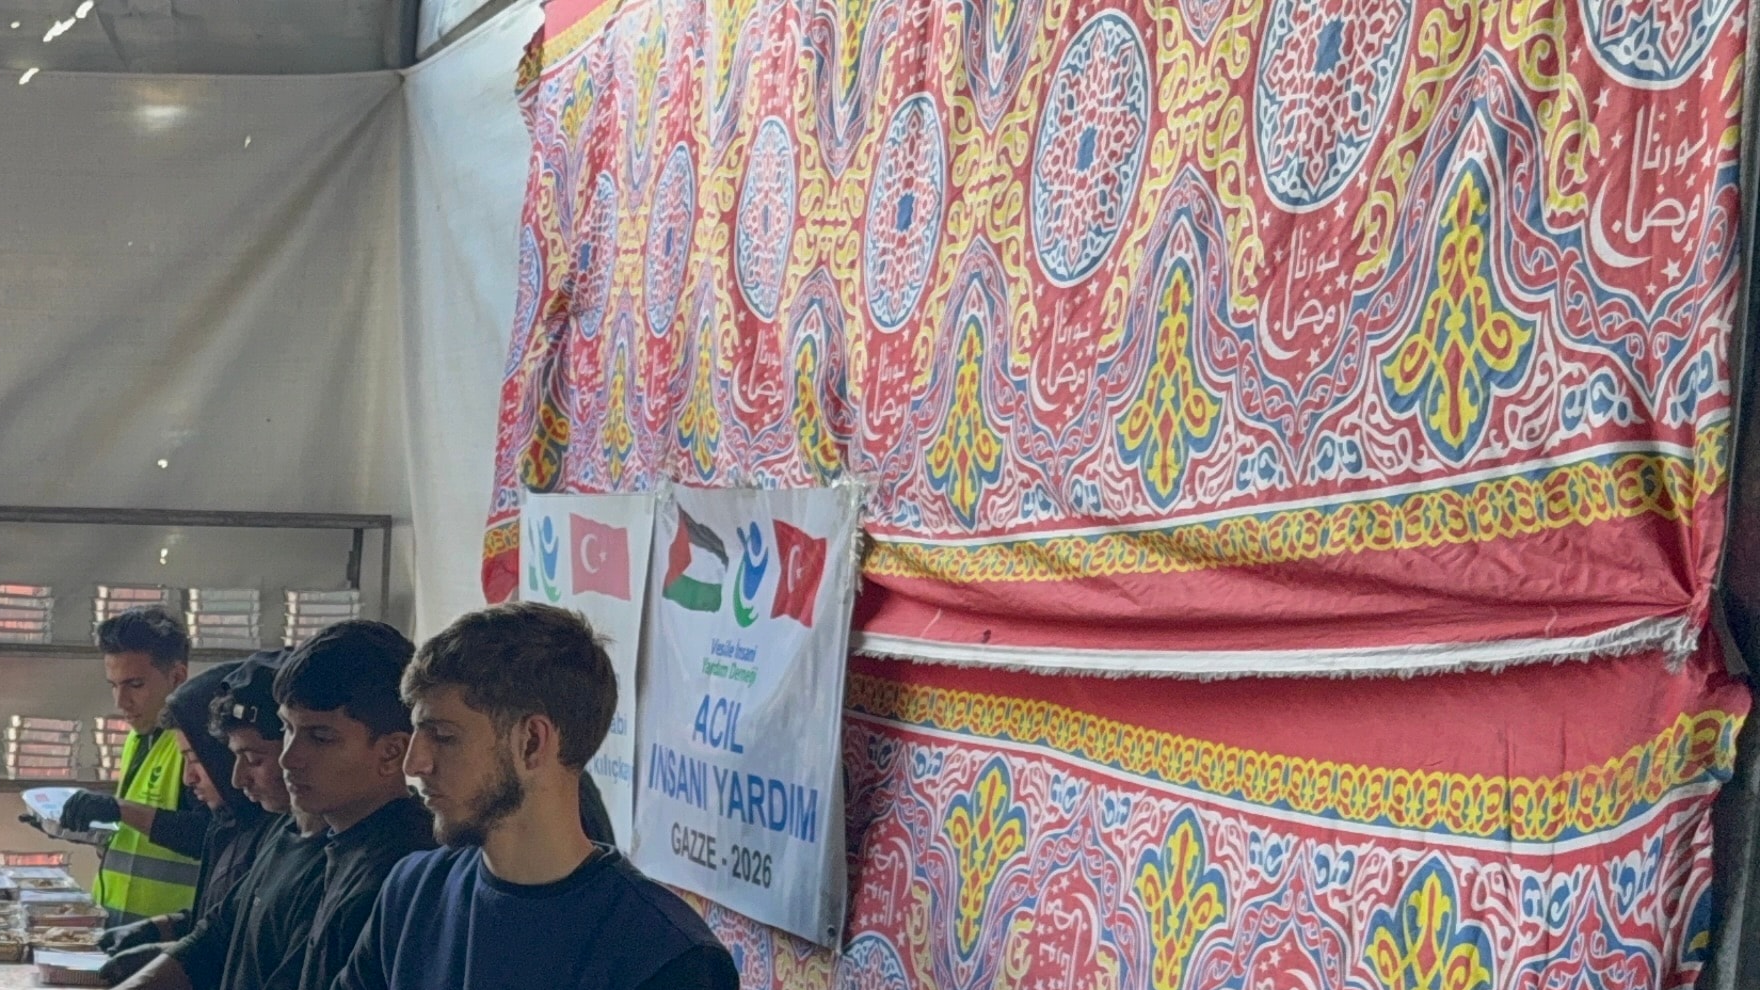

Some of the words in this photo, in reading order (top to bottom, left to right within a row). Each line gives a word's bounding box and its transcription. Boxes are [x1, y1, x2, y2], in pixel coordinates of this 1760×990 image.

[1642, 102, 1709, 176] نورنا
[1589, 104, 1710, 268] رمضان
[1294, 224, 1340, 282] نورنا
[1260, 227, 1344, 360] رمضان
[713, 765, 818, 843] YARDIM
[671, 822, 716, 871] GAZZE
[731, 844, 773, 888] 2026
